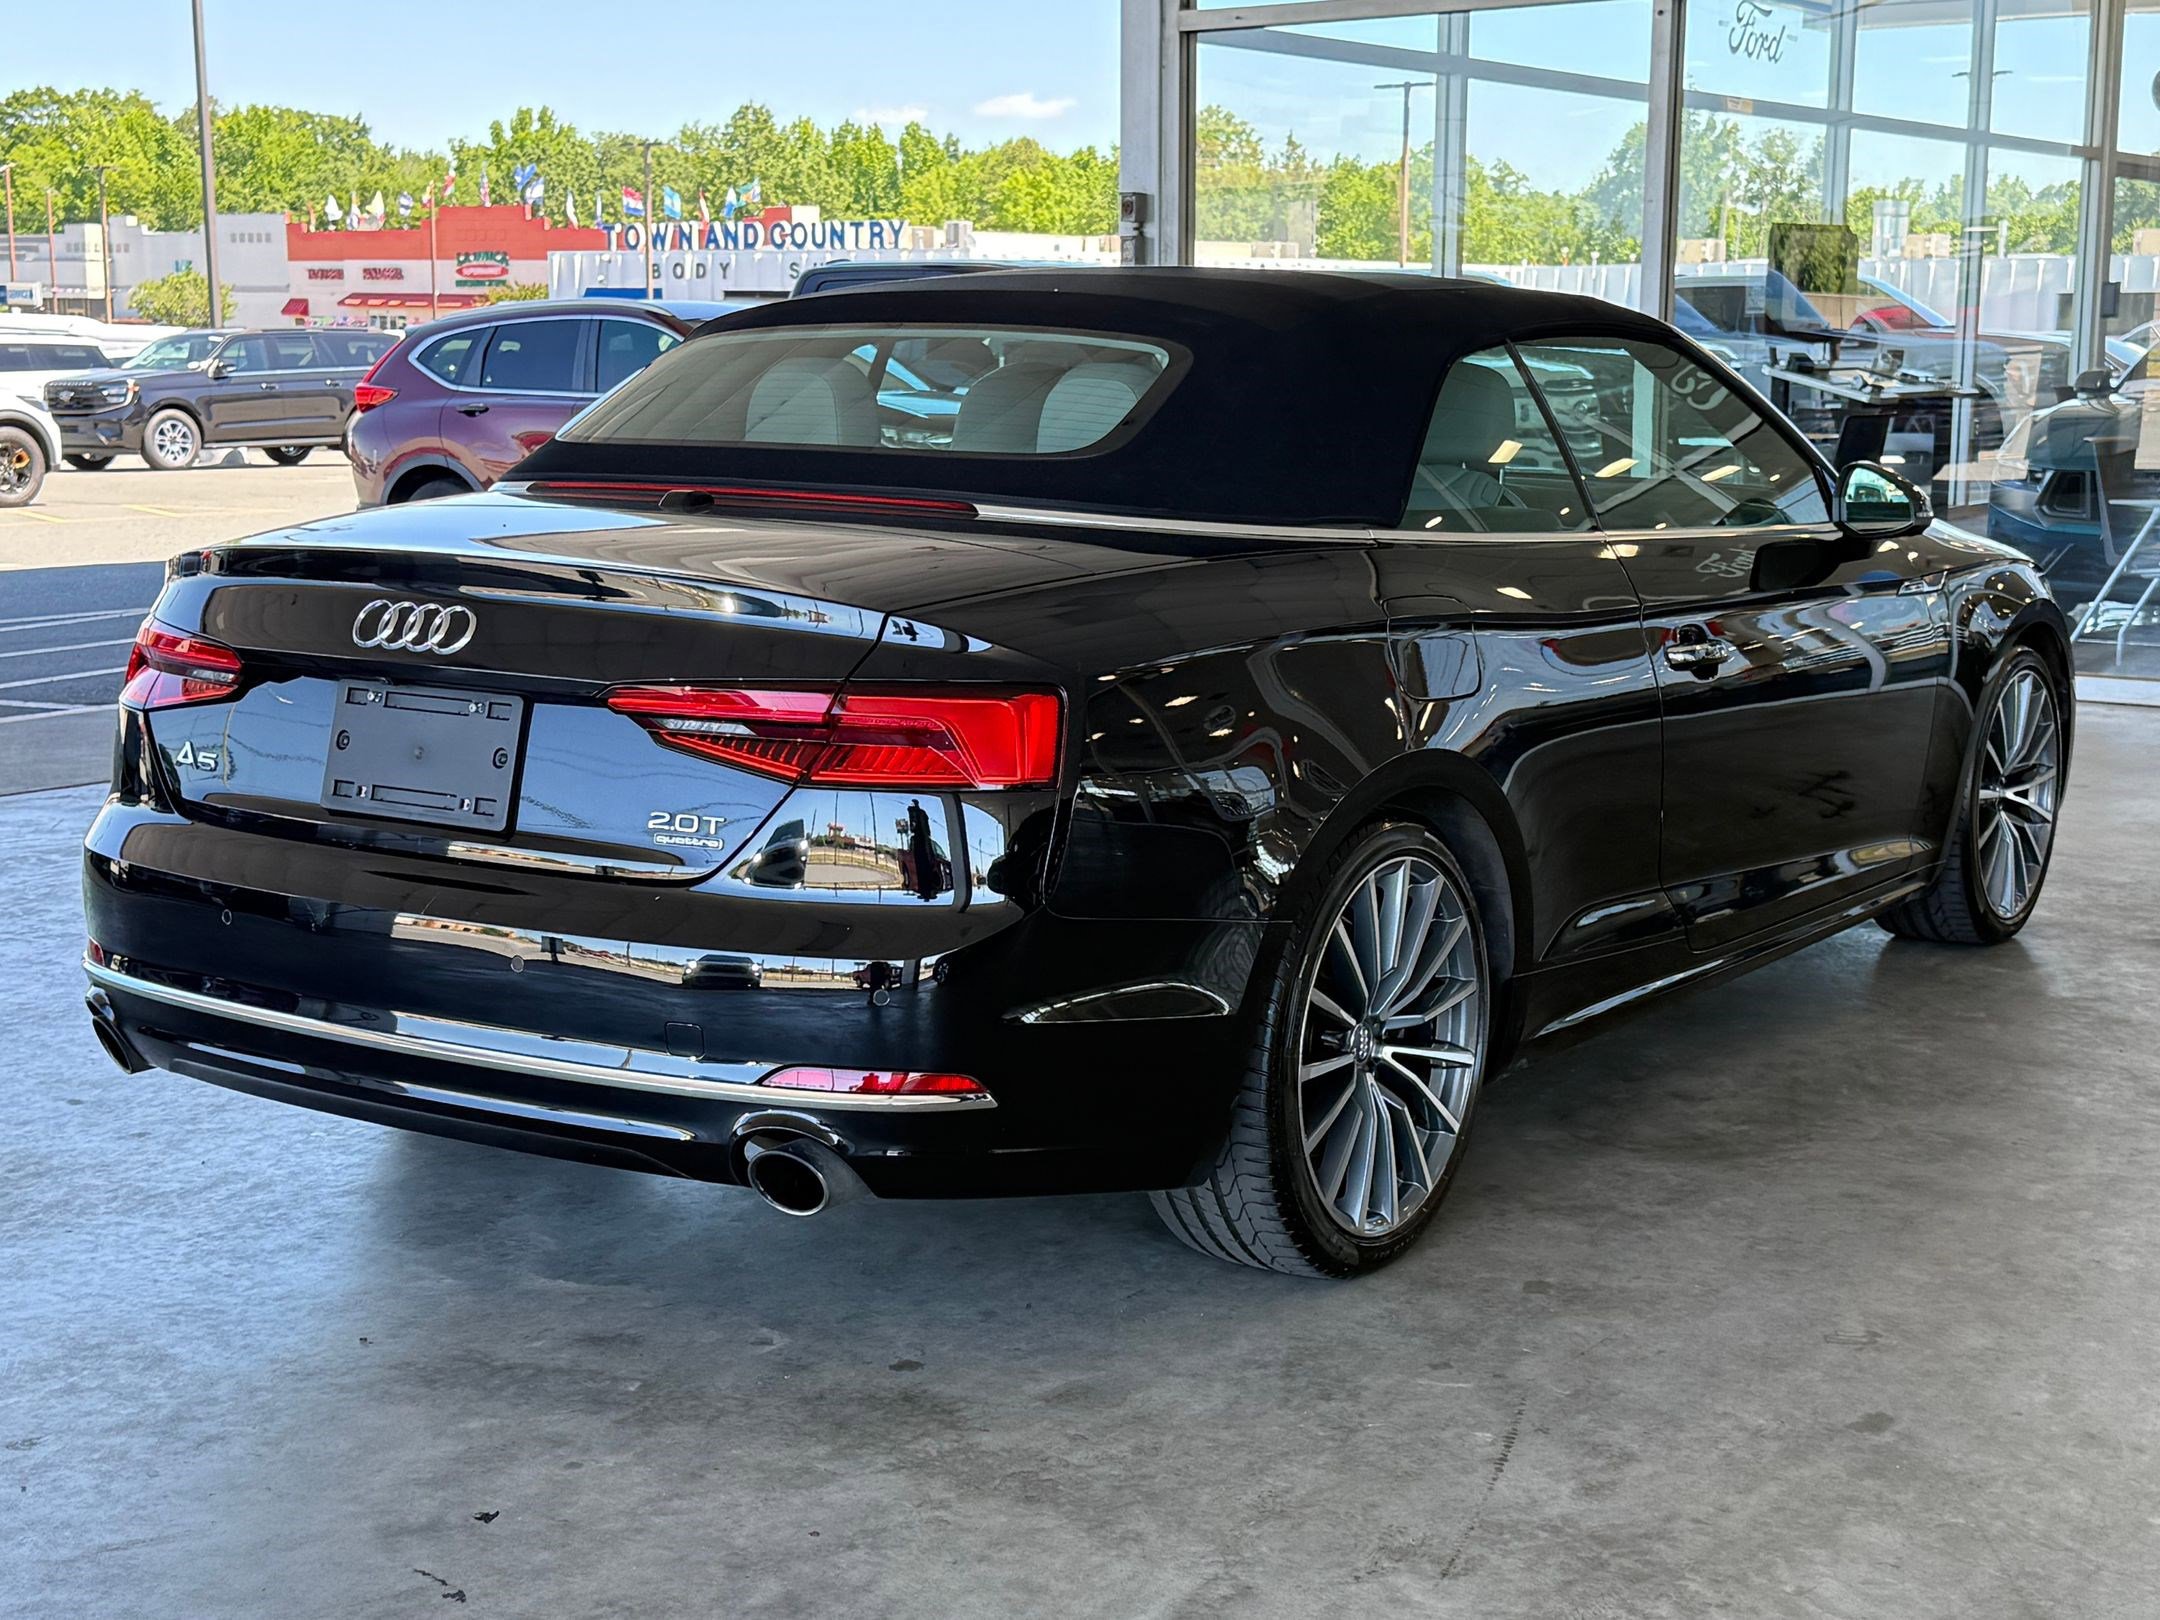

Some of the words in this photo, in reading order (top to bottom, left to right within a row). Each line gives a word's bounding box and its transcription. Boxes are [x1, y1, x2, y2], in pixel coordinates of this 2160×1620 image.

[1728, 0, 1786, 64] Ford
[602, 222, 694, 250] TOWN
[705, 222, 758, 250] AND
[770, 221, 904, 250] COUNTRY
[652, 262, 730, 280] BODY
[176, 741, 217, 771] A5
[647, 811, 726, 835] 2.0T
[655, 834, 720, 848] quattro
